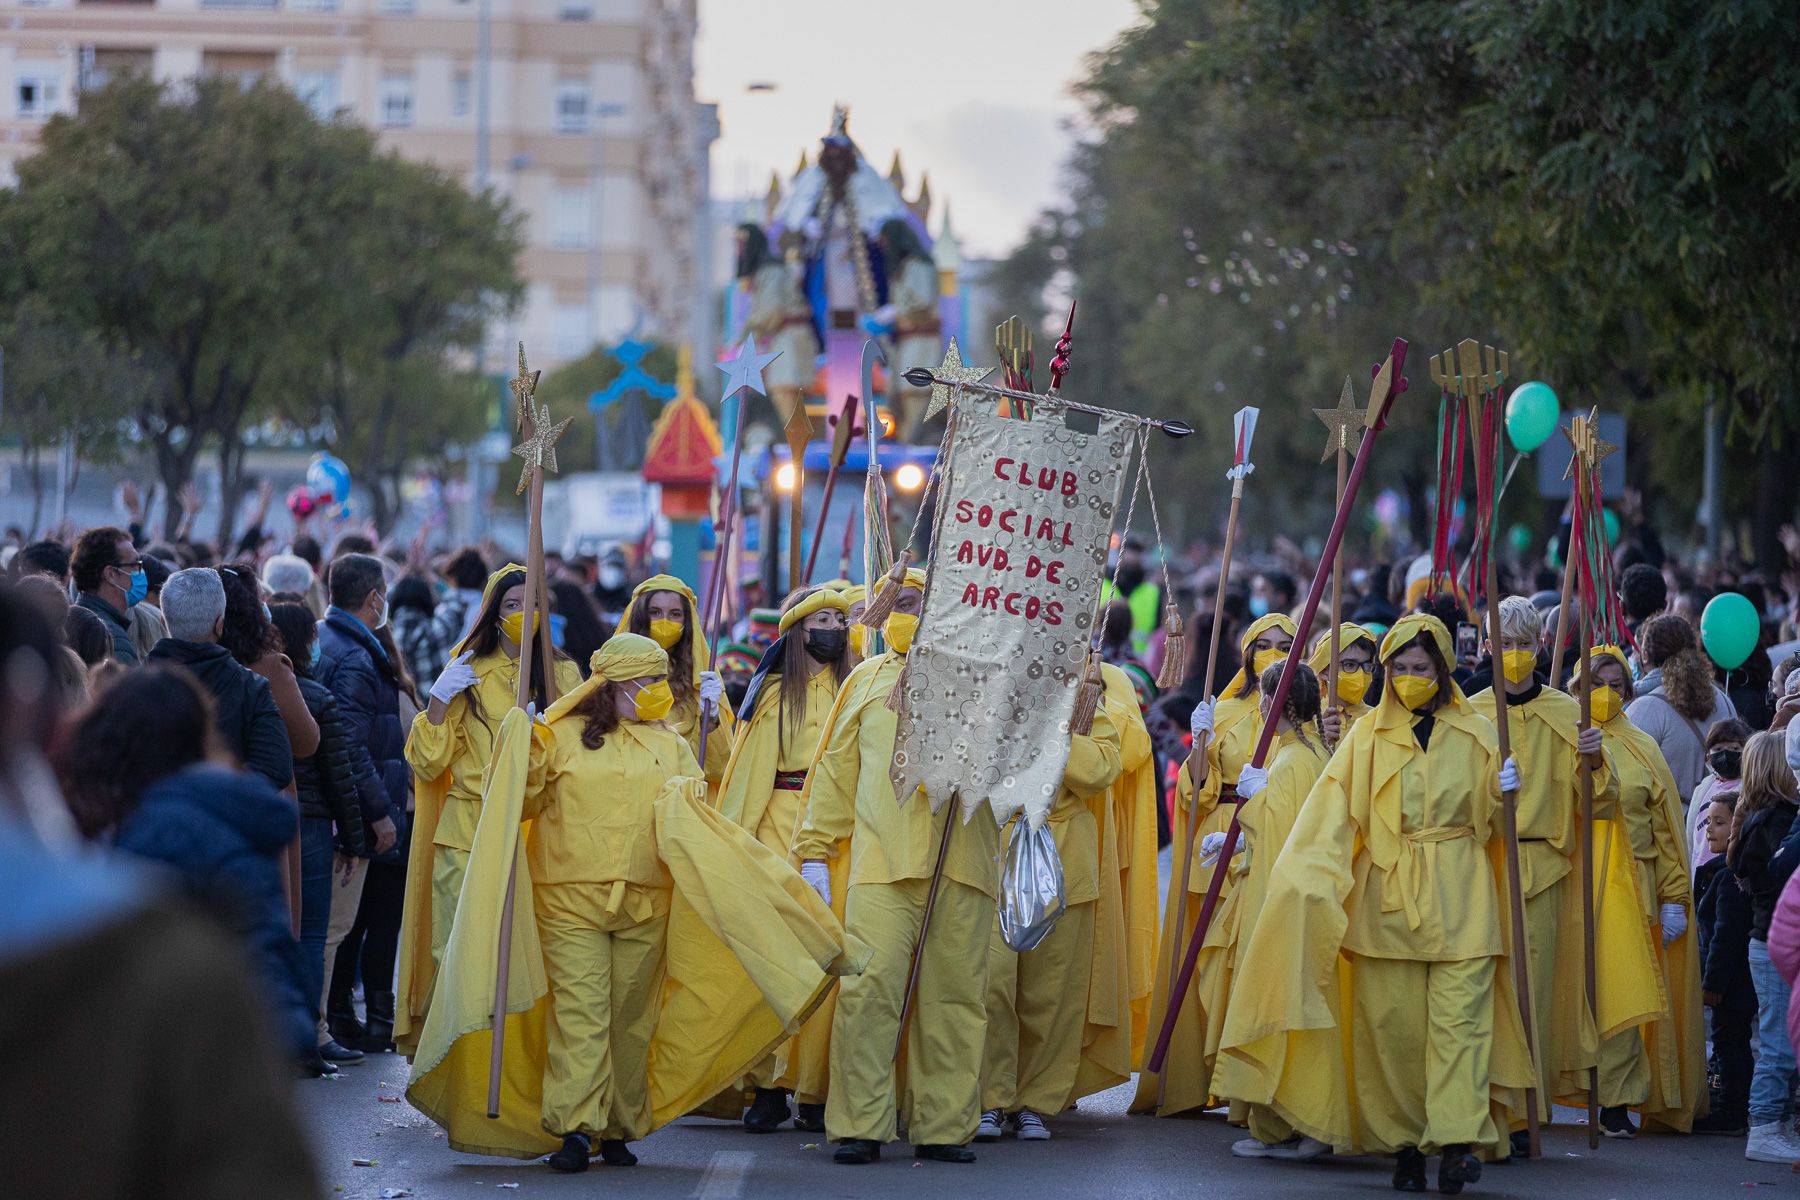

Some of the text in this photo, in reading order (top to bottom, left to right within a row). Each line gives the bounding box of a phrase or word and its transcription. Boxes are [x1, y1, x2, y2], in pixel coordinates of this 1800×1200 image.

[994, 458, 1077, 496] CLUB
[955, 500, 1074, 545] SOCIAL
[957, 540, 1064, 584] AVD. DE
[961, 582, 1064, 626] ARCOS
